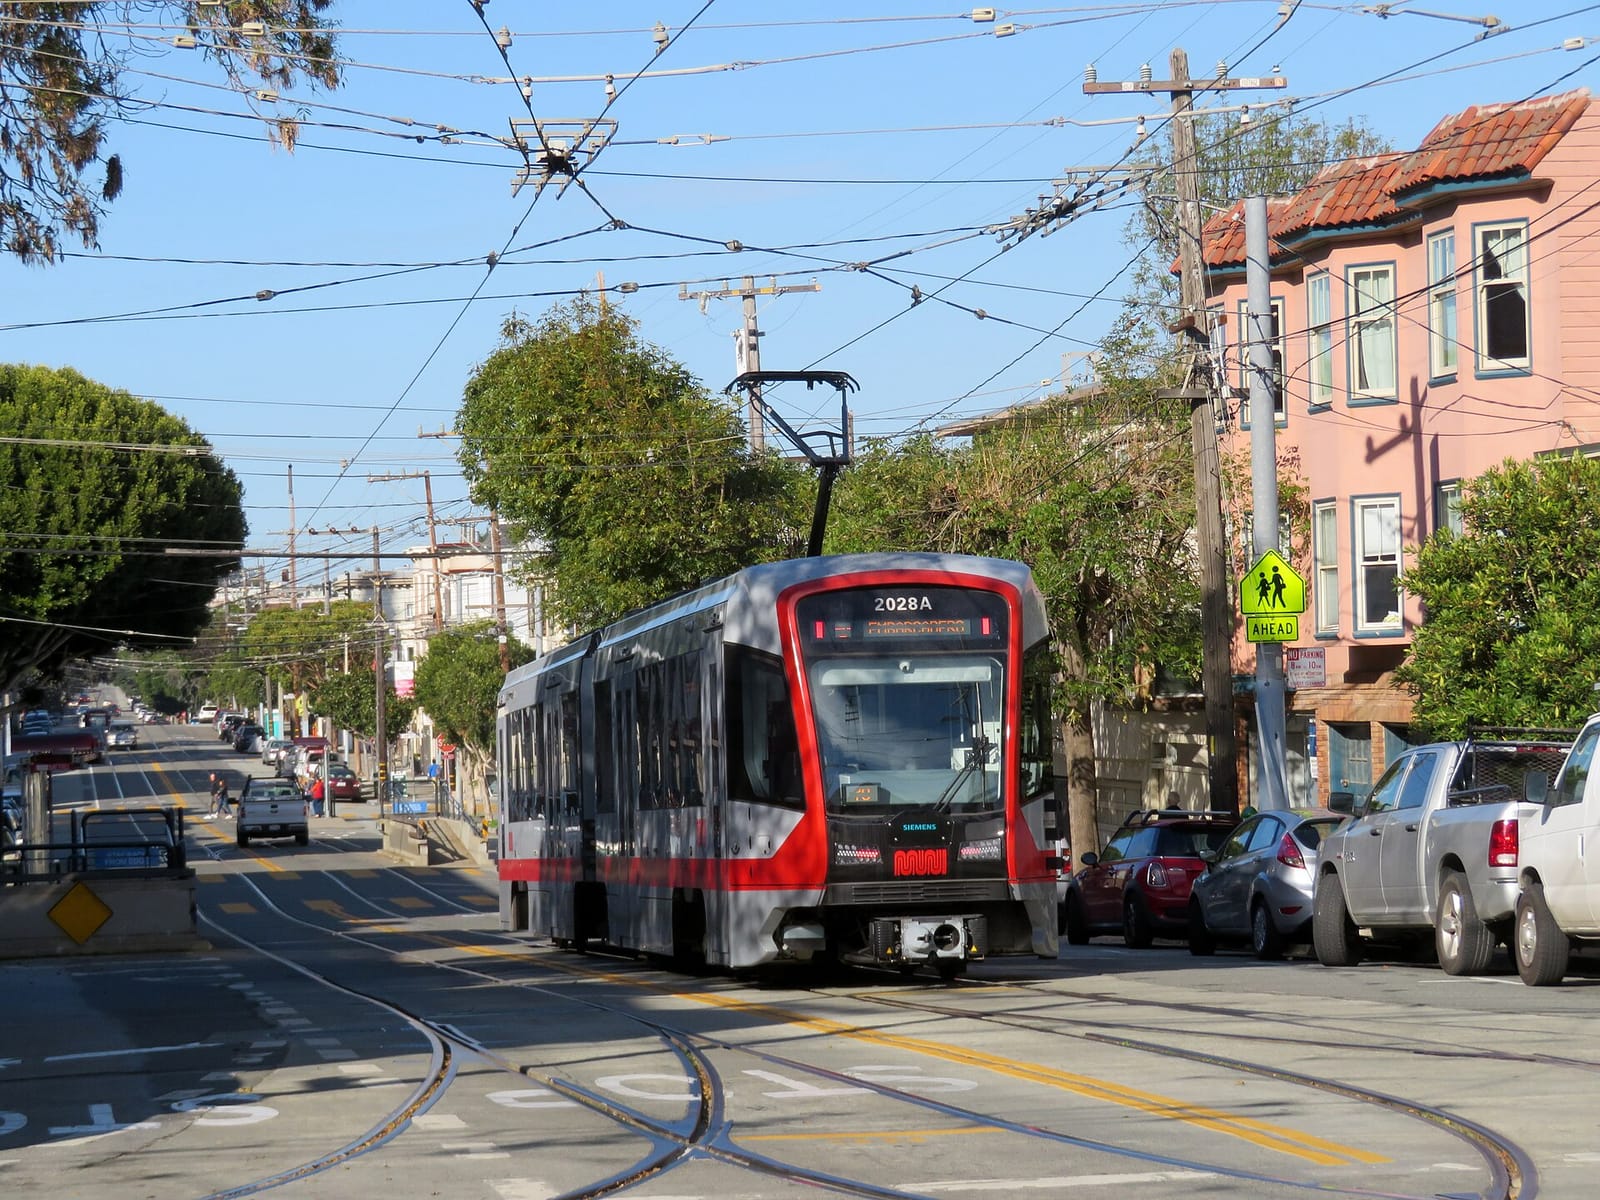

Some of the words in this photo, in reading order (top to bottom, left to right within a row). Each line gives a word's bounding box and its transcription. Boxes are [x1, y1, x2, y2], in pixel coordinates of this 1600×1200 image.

[874, 596, 932, 611] 2028A
[1252, 622, 1293, 636] AHEAD
[1288, 649, 1298, 660] NO
[1300, 650, 1323, 659] PARKING
